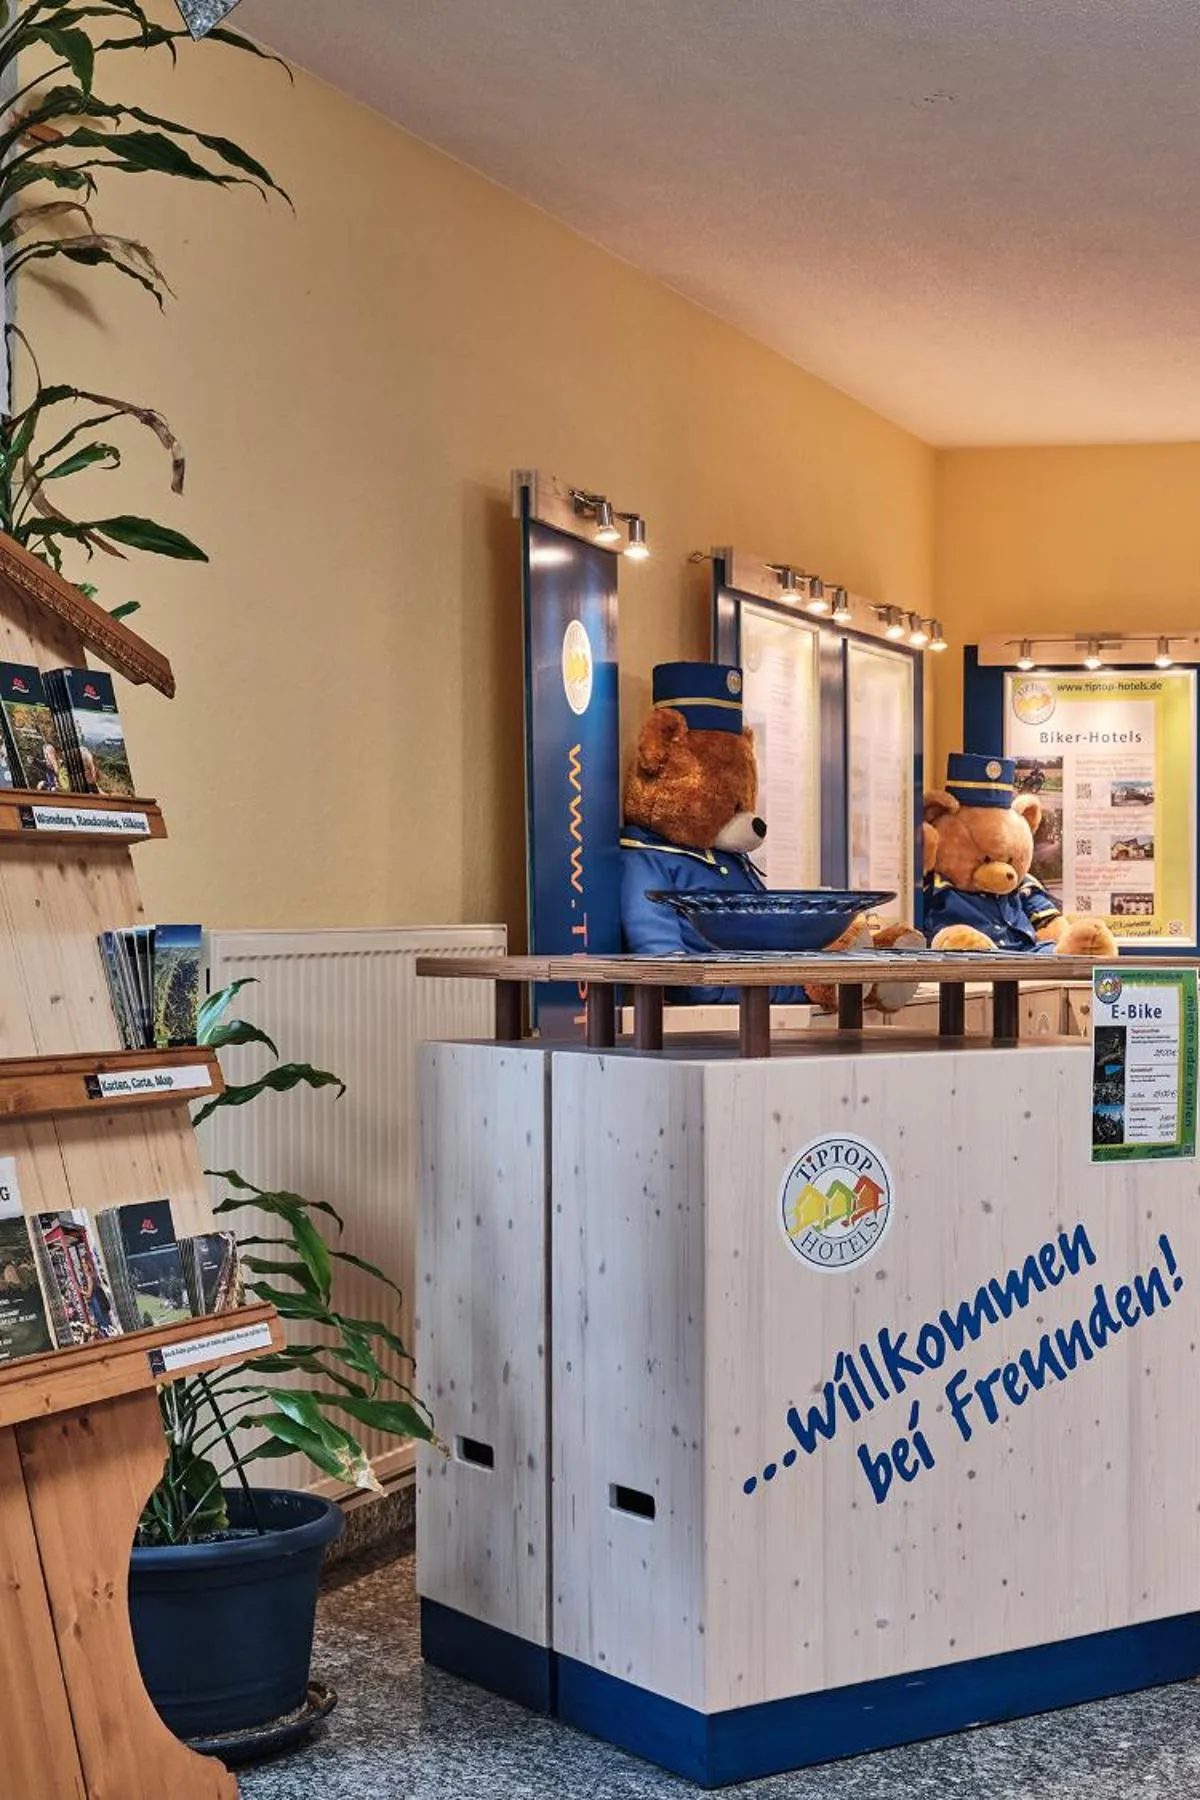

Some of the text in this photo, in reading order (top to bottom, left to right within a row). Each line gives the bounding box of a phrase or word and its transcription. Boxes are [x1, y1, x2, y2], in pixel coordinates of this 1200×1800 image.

[1039, 730, 1143, 744] Biker-Hotels
[1111, 1003, 1162, 1019] E-Bike
[101, 1079, 132, 1092] Karten,
[154, 1075, 174, 1088] Map
[800, 1218, 879, 1261] HOTELS
[743, 1223, 1097, 1495] ...willkommen
[857, 1234, 1184, 1505] bei Freunden!
